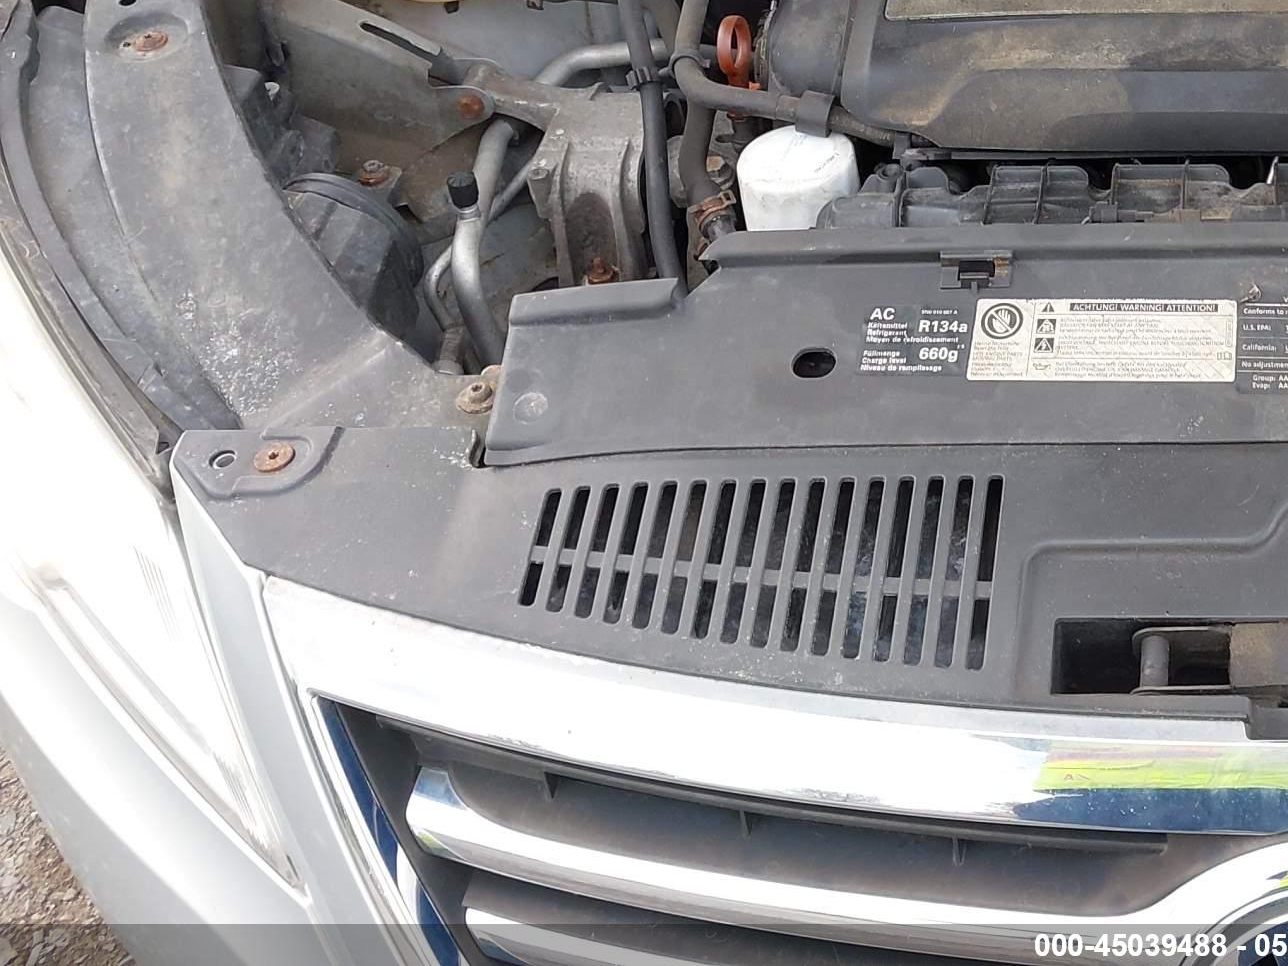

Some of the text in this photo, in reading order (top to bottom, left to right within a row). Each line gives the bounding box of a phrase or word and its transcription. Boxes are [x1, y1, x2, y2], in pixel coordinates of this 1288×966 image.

[1072, 304, 1216, 312] ACHTUNG! WARNING! ATTENTION!
[1243, 307, 1275, 315] Conforms
[1277, 307, 1284, 315] to
[870, 308, 895, 320] AC
[918, 319, 968, 333] R134a
[1242, 344, 1277, 352] California:
[919, 347, 958, 362] 660g
[862, 357, 886, 365] Charge
